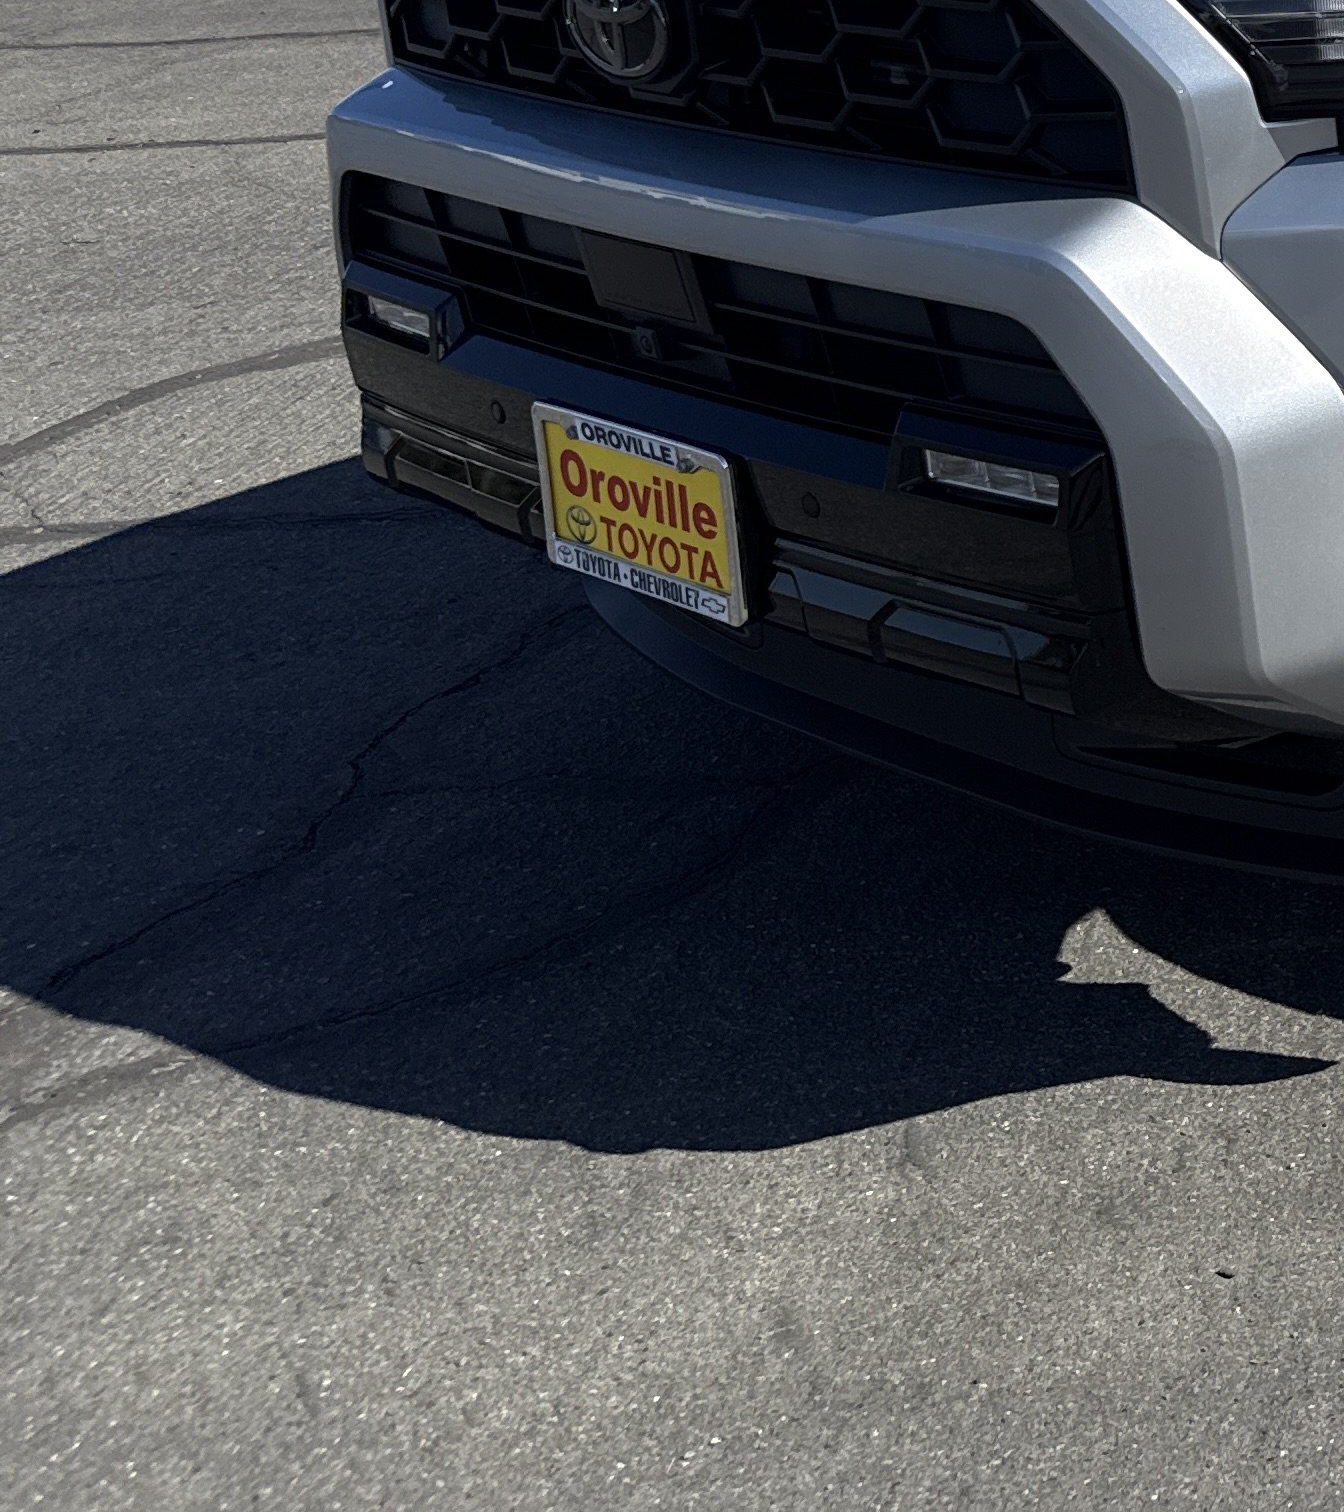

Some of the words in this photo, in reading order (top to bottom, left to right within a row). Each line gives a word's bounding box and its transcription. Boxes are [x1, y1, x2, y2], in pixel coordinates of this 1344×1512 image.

[580, 422, 675, 466] OROVILLE
[560, 449, 719, 540] Oroville
[573, 549, 622, 583] TOYOTA
[629, 568, 701, 610] CHEVROLET
[600, 516, 724, 589] TOYOTA
